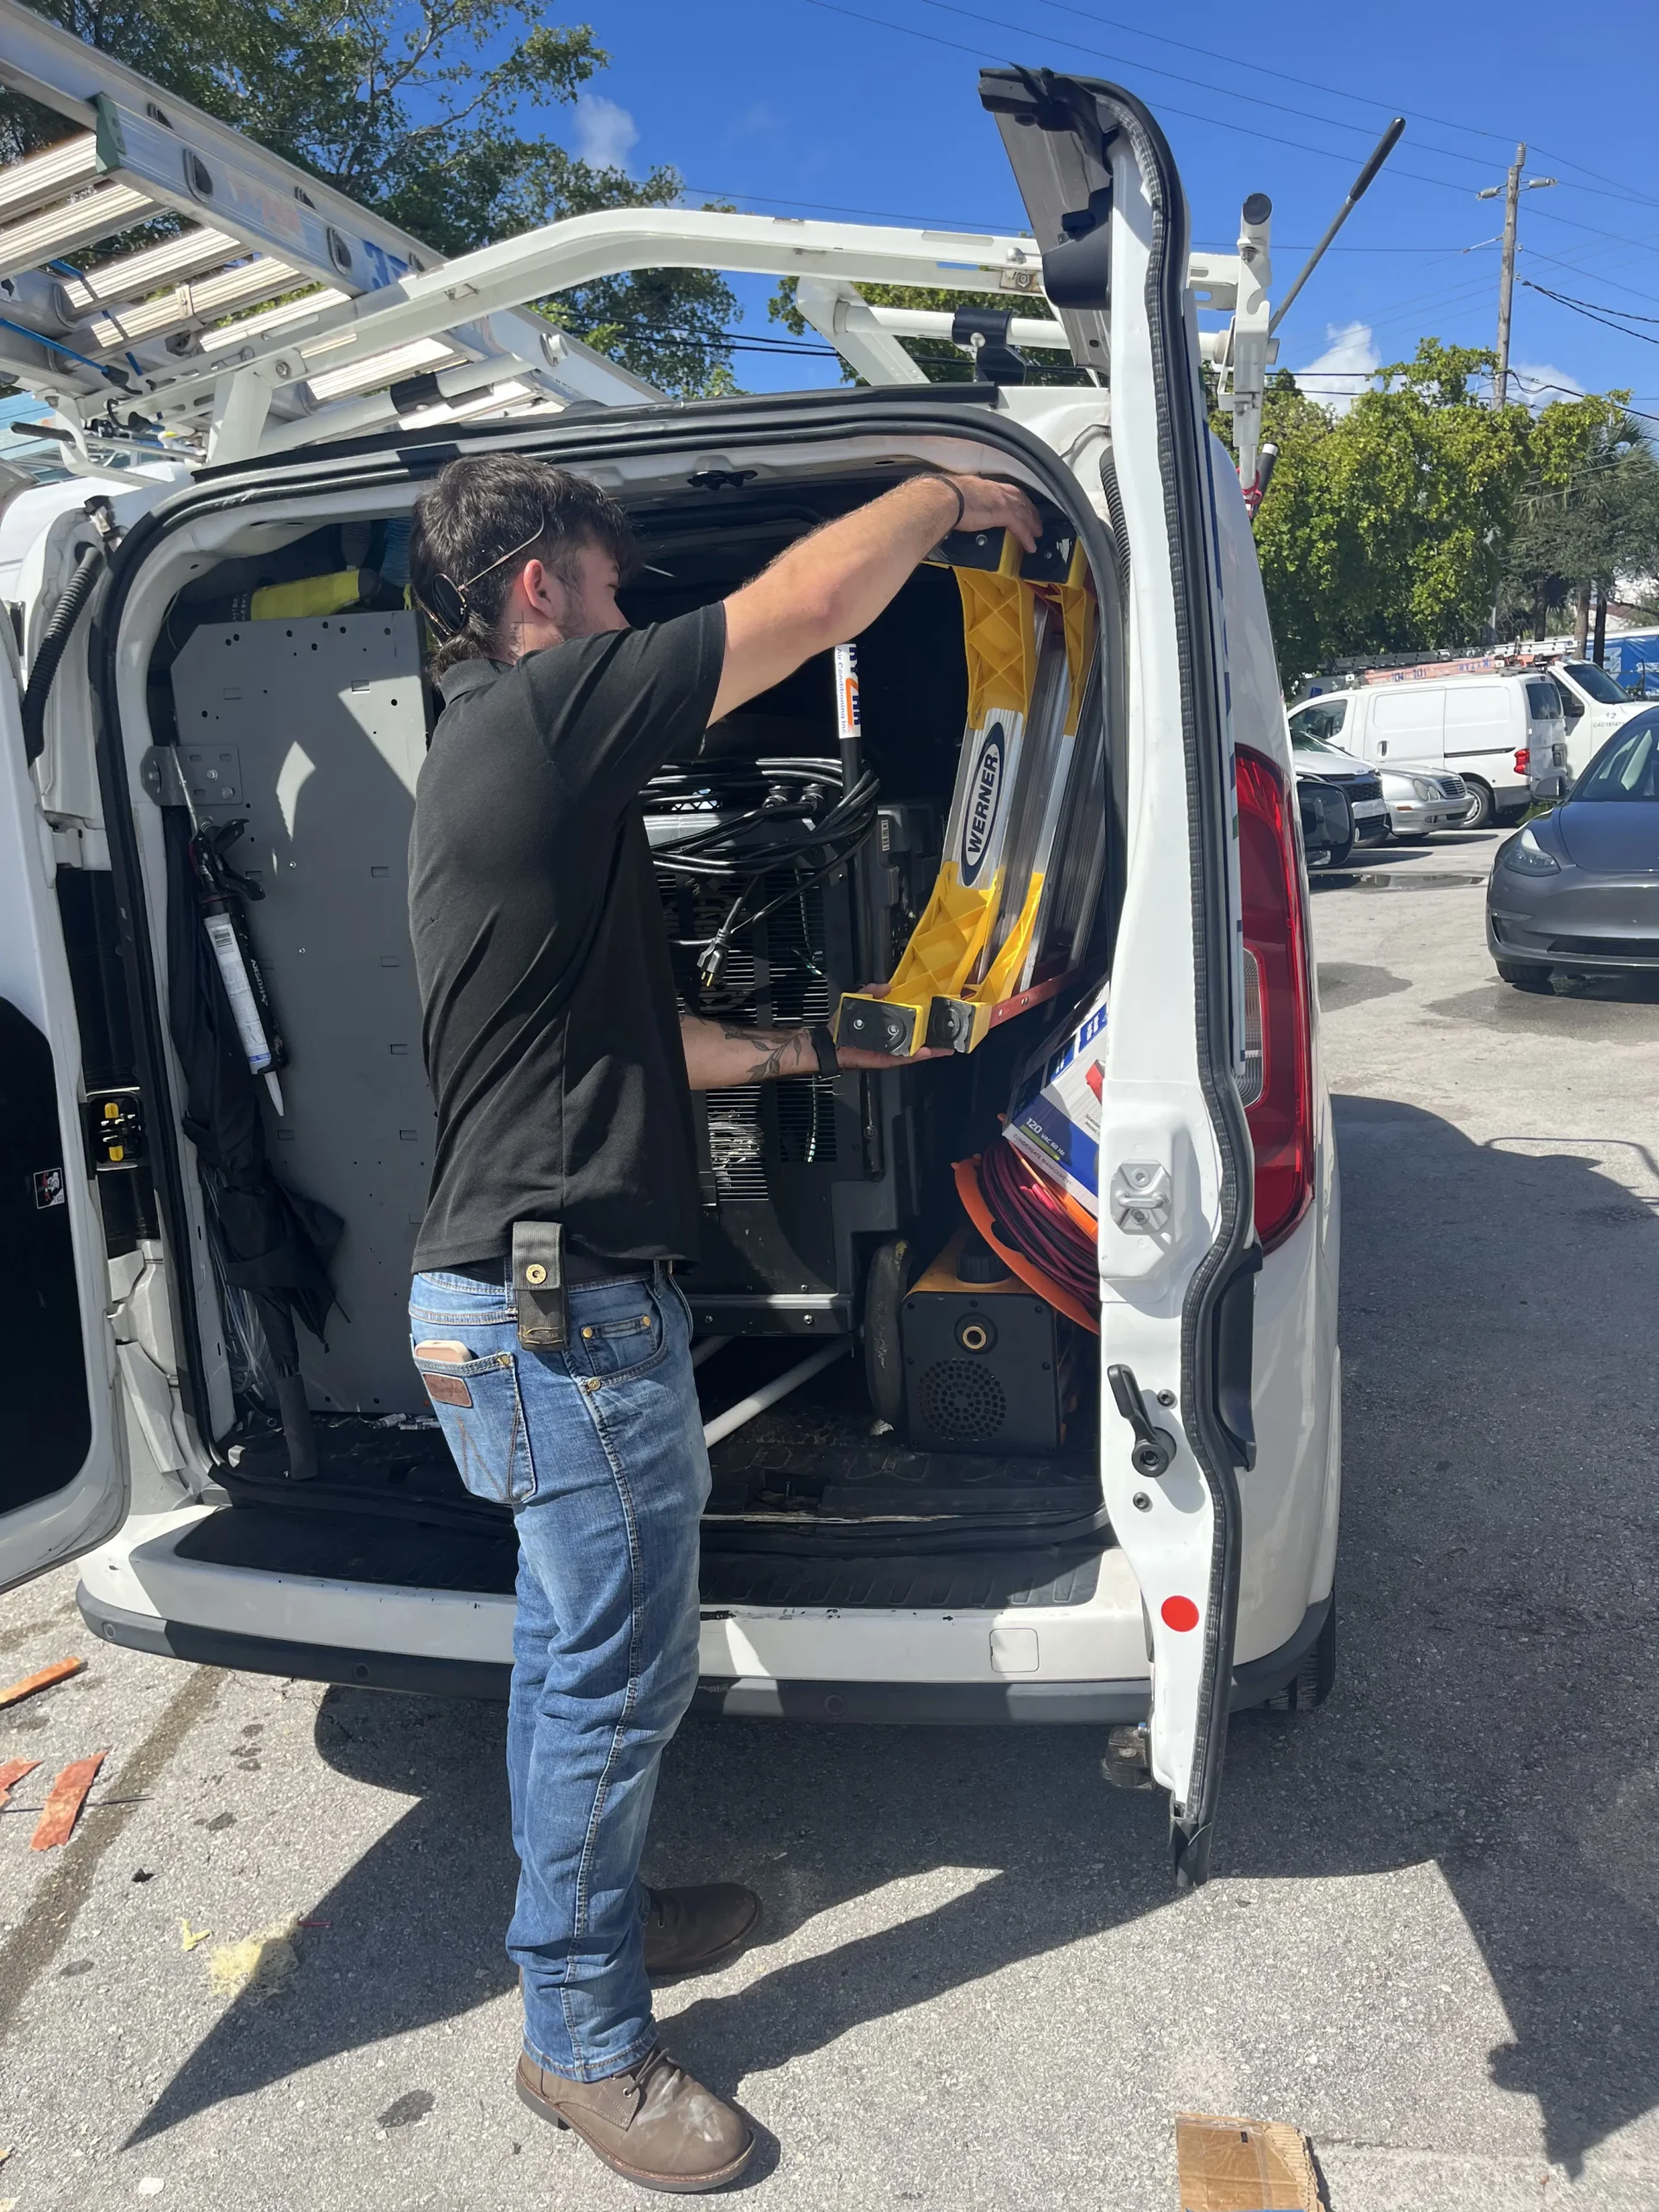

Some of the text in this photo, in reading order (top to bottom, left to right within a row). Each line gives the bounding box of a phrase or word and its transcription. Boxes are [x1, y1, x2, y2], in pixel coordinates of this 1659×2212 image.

[837, 662, 846, 719] Conditioning
[968, 753, 999, 854] WERNER
[1013, 1133, 1072, 1185] CONDENSATE MANAGEMENT
[1026, 1117, 1065, 1156] 120 VAC 60 Hz
